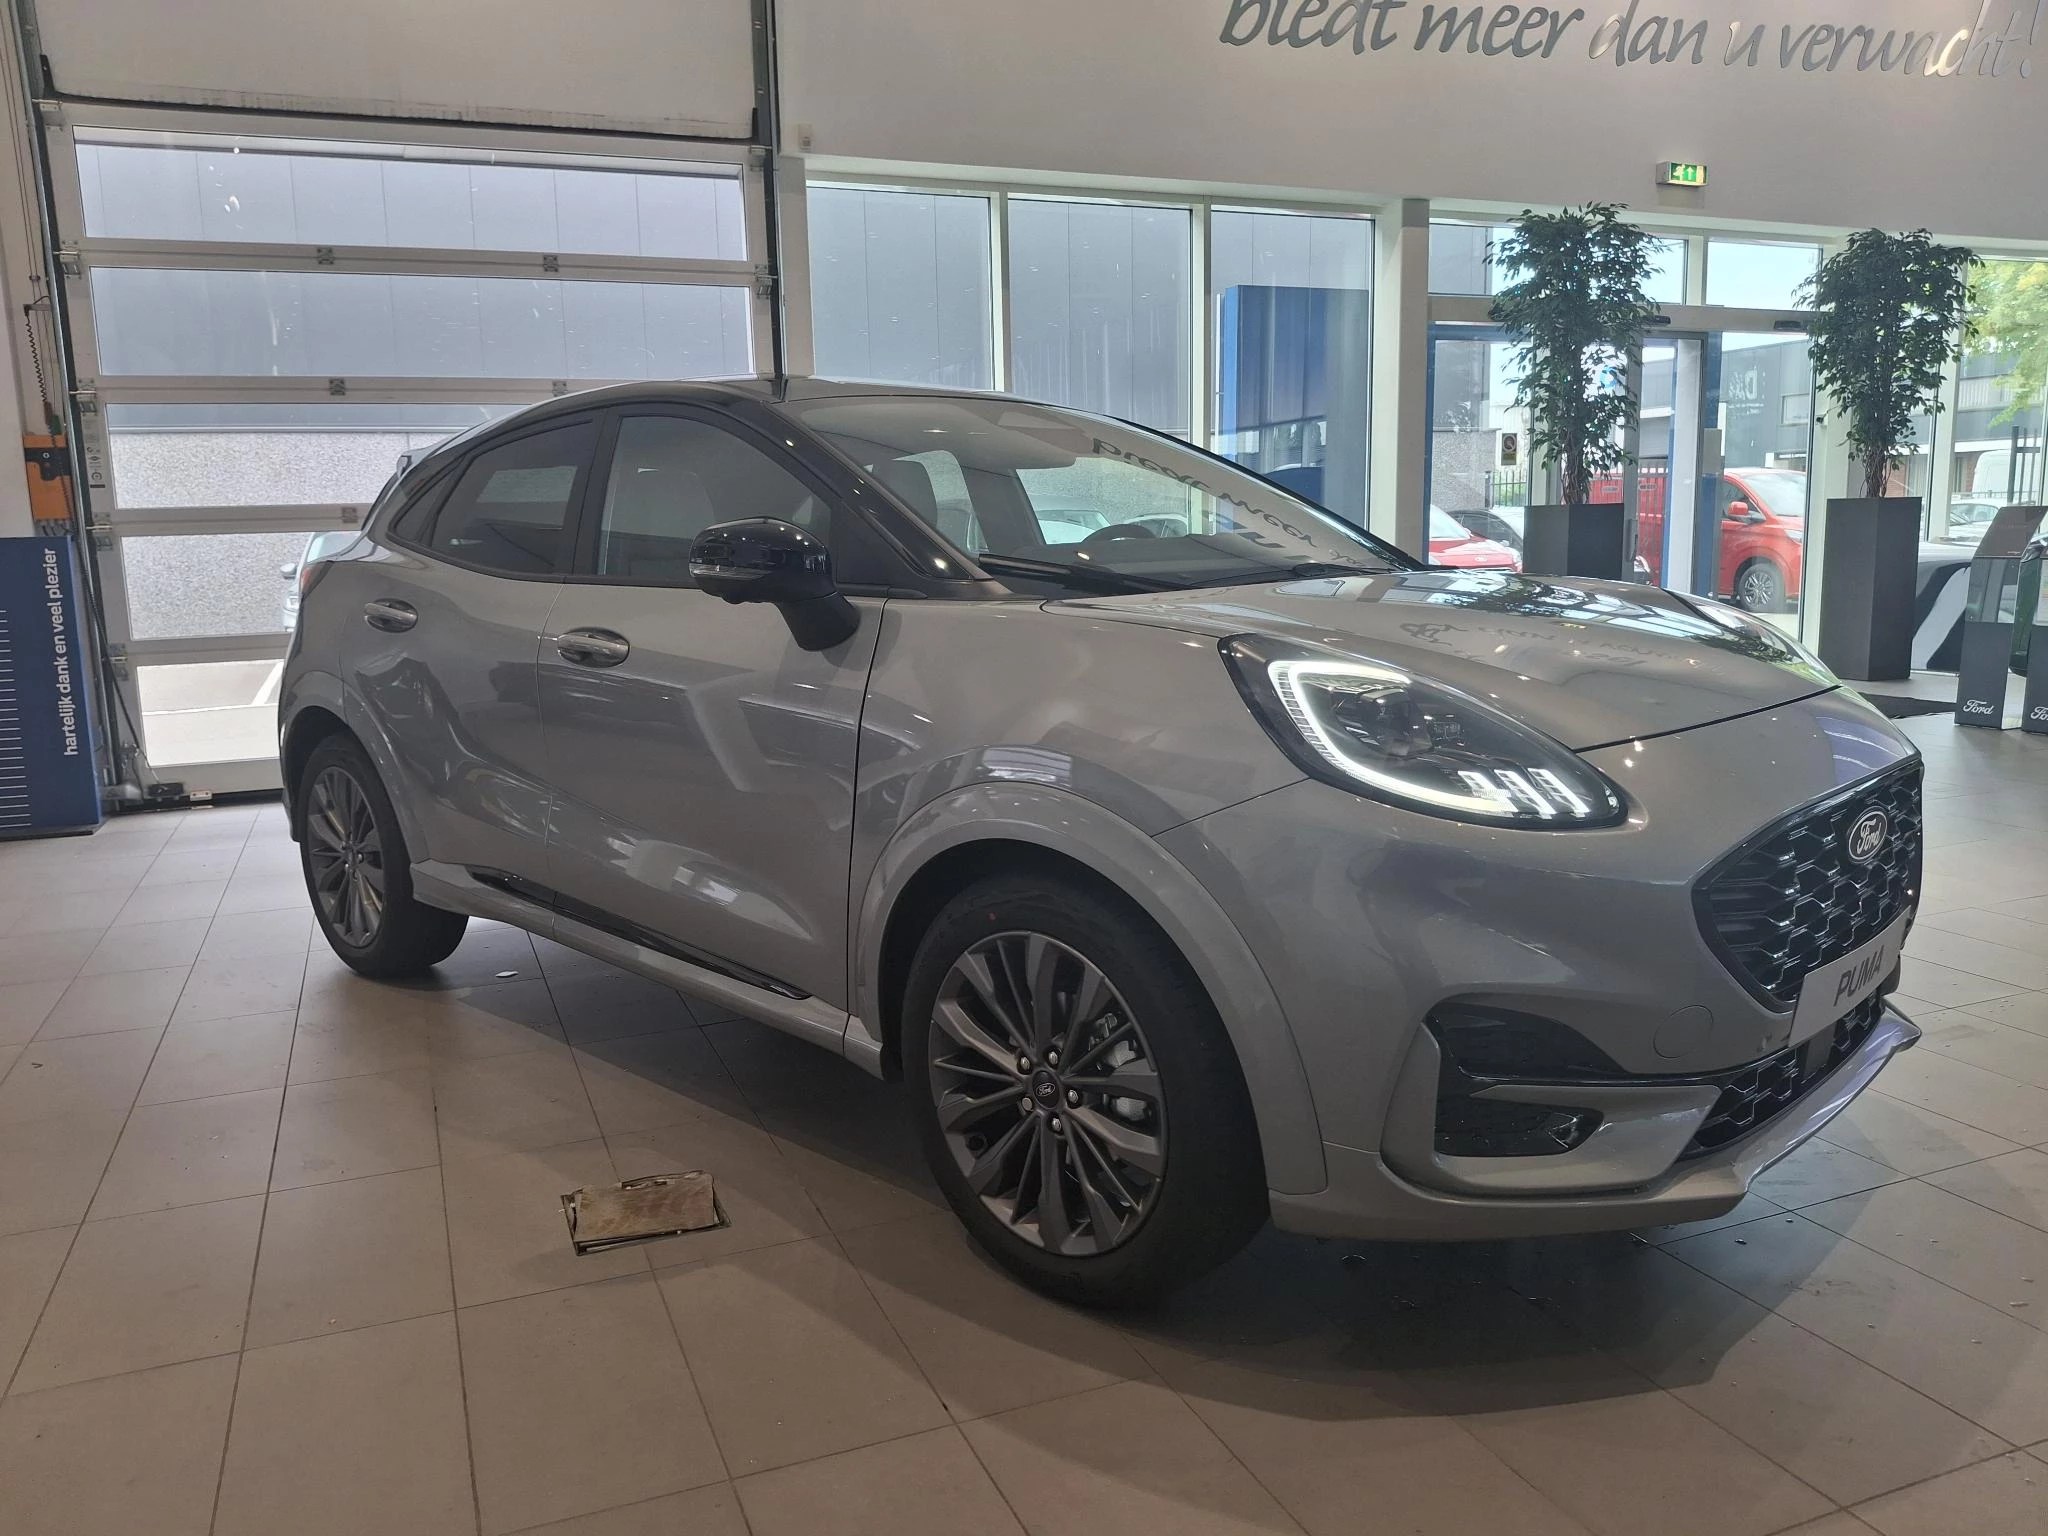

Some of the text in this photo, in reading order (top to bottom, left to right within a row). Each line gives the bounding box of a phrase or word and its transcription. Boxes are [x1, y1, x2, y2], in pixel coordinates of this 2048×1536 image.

[1413, 5, 1585, 58] meer
[1589, 0, 1709, 67] dan
[1723, 21, 1766, 67] u
[42, 548, 79, 756] hartelijk dank en veel plezier
[1963, 699, 1995, 715] Ford
[2030, 706, 2048, 720] Fo
[1857, 817, 1882, 855] Ford
[1834, 945, 1884, 1007] PUMA
